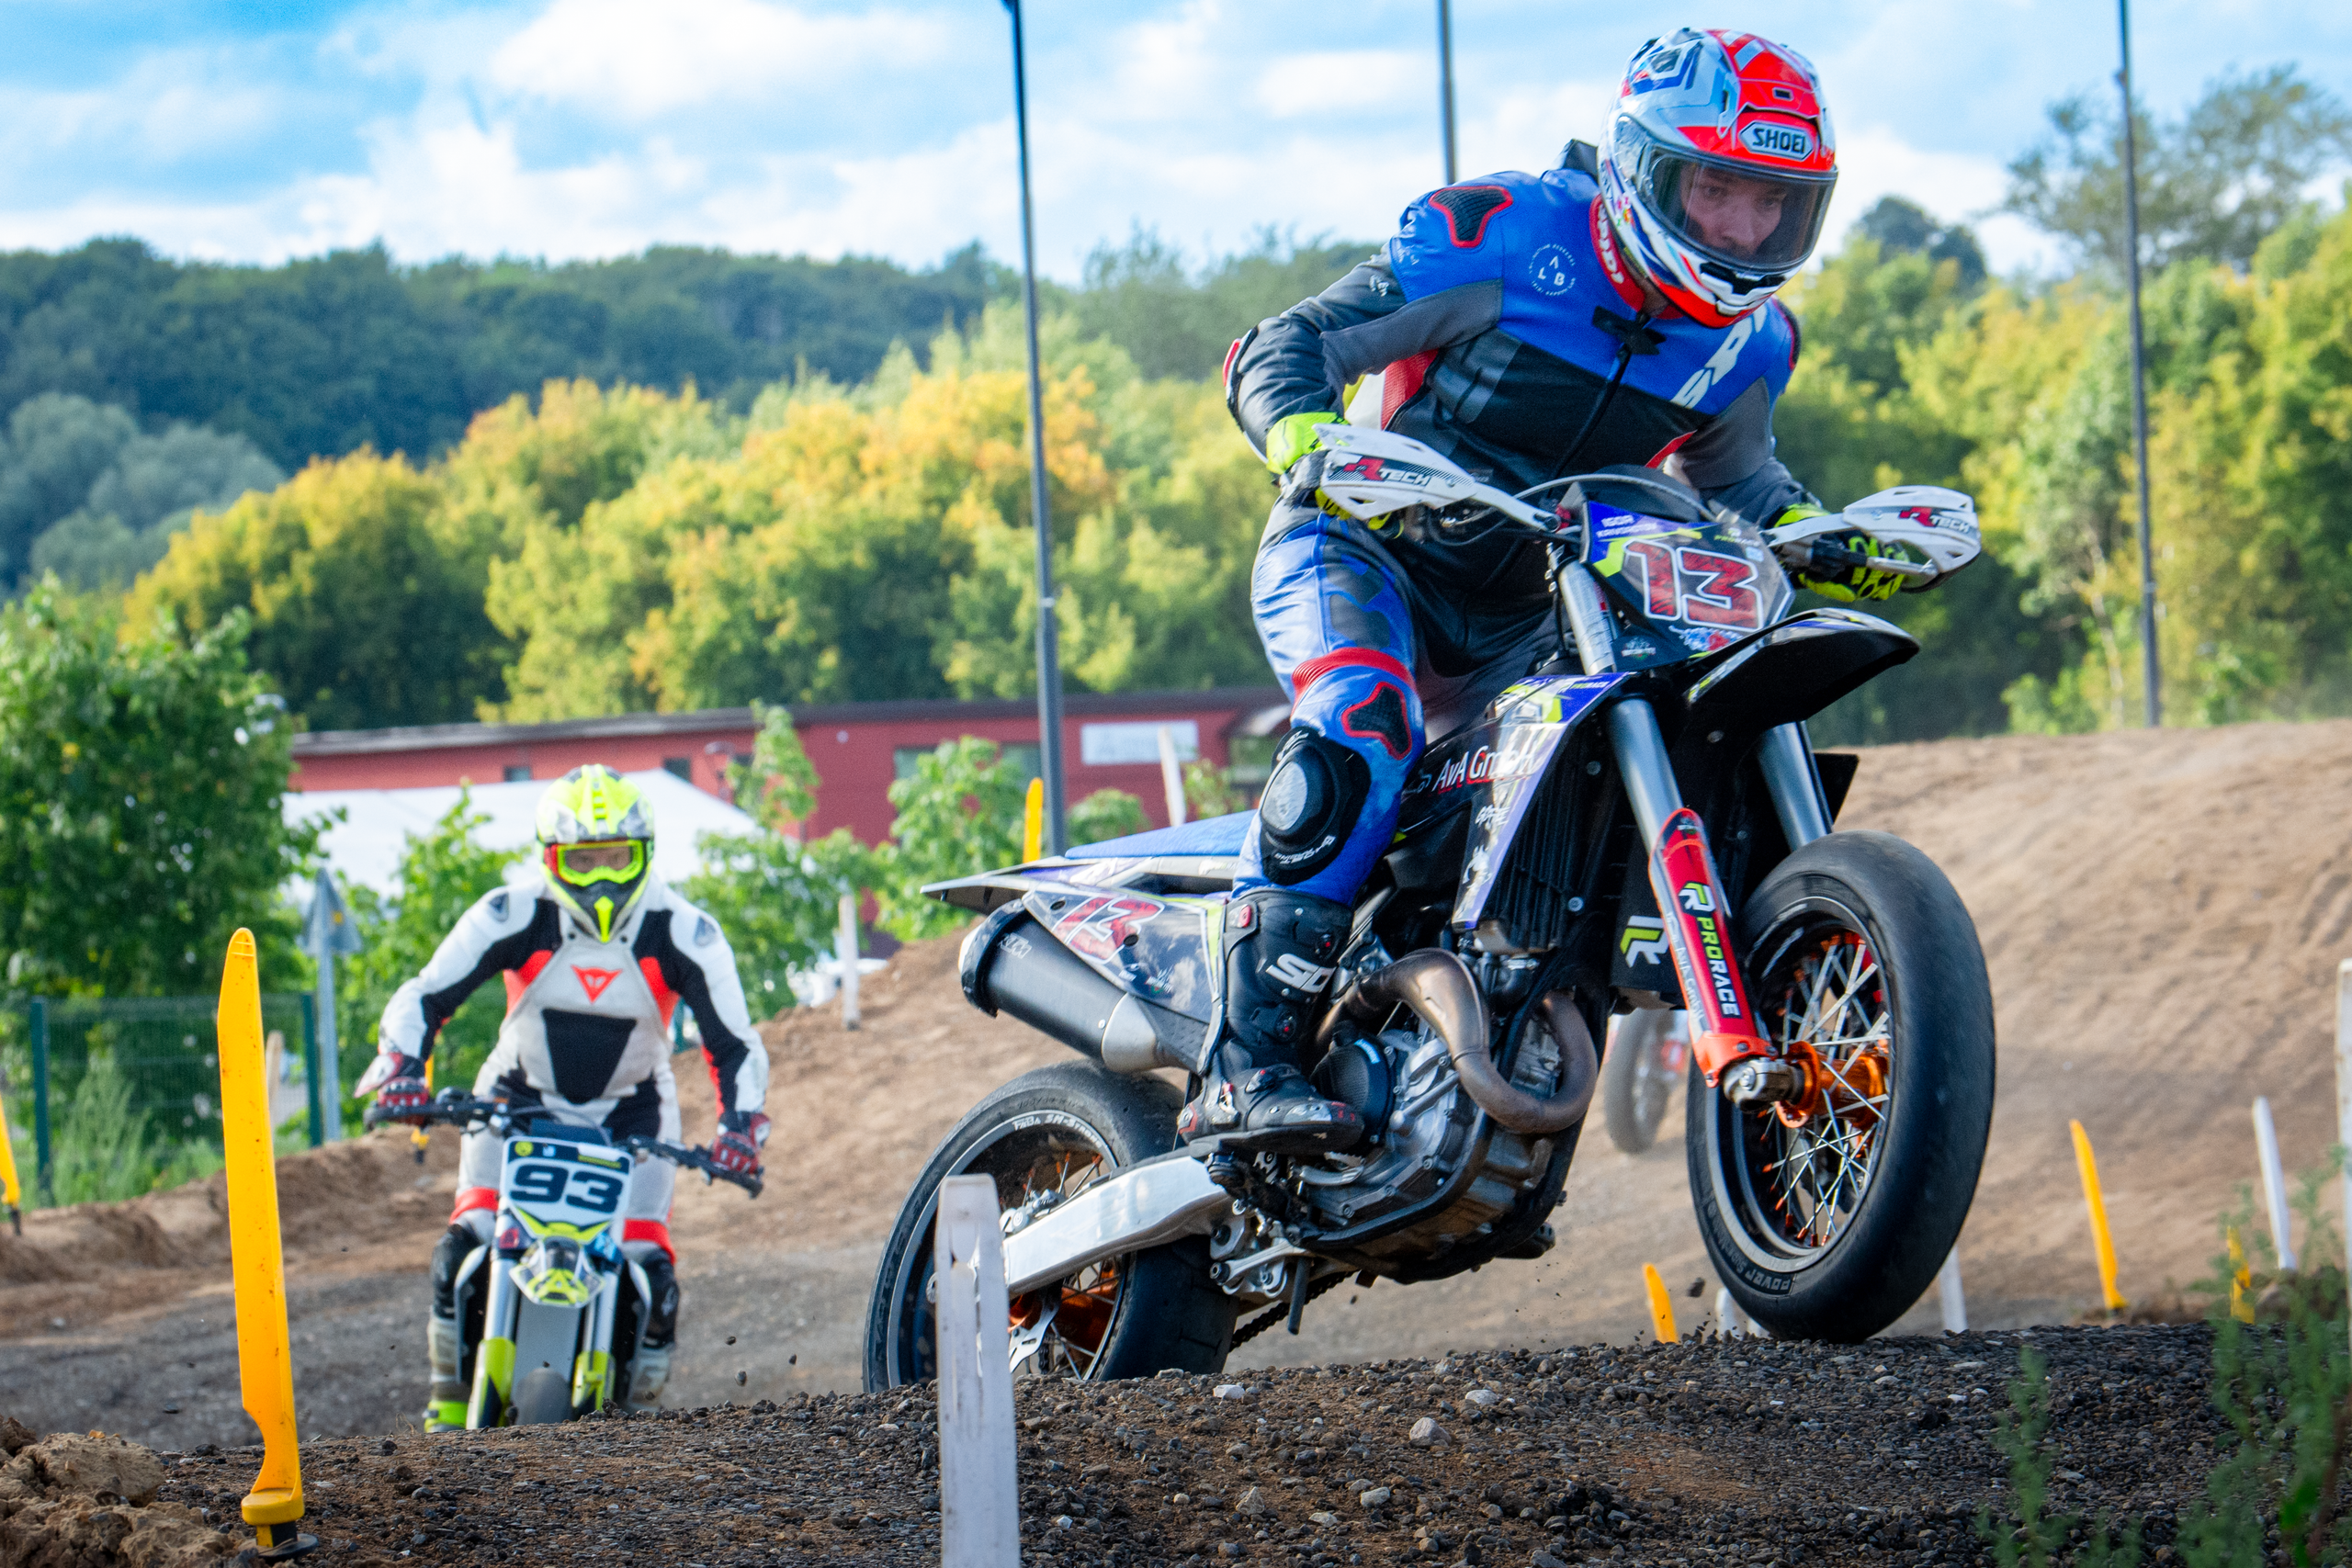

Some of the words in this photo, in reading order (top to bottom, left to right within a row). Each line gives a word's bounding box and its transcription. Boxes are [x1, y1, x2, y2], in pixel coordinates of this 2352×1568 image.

[1752, 127, 1807, 154] SHOEI
[1622, 537, 1764, 634] 13
[1696, 916, 1742, 1019] PRORACE
[508, 1164, 625, 1214] 93
